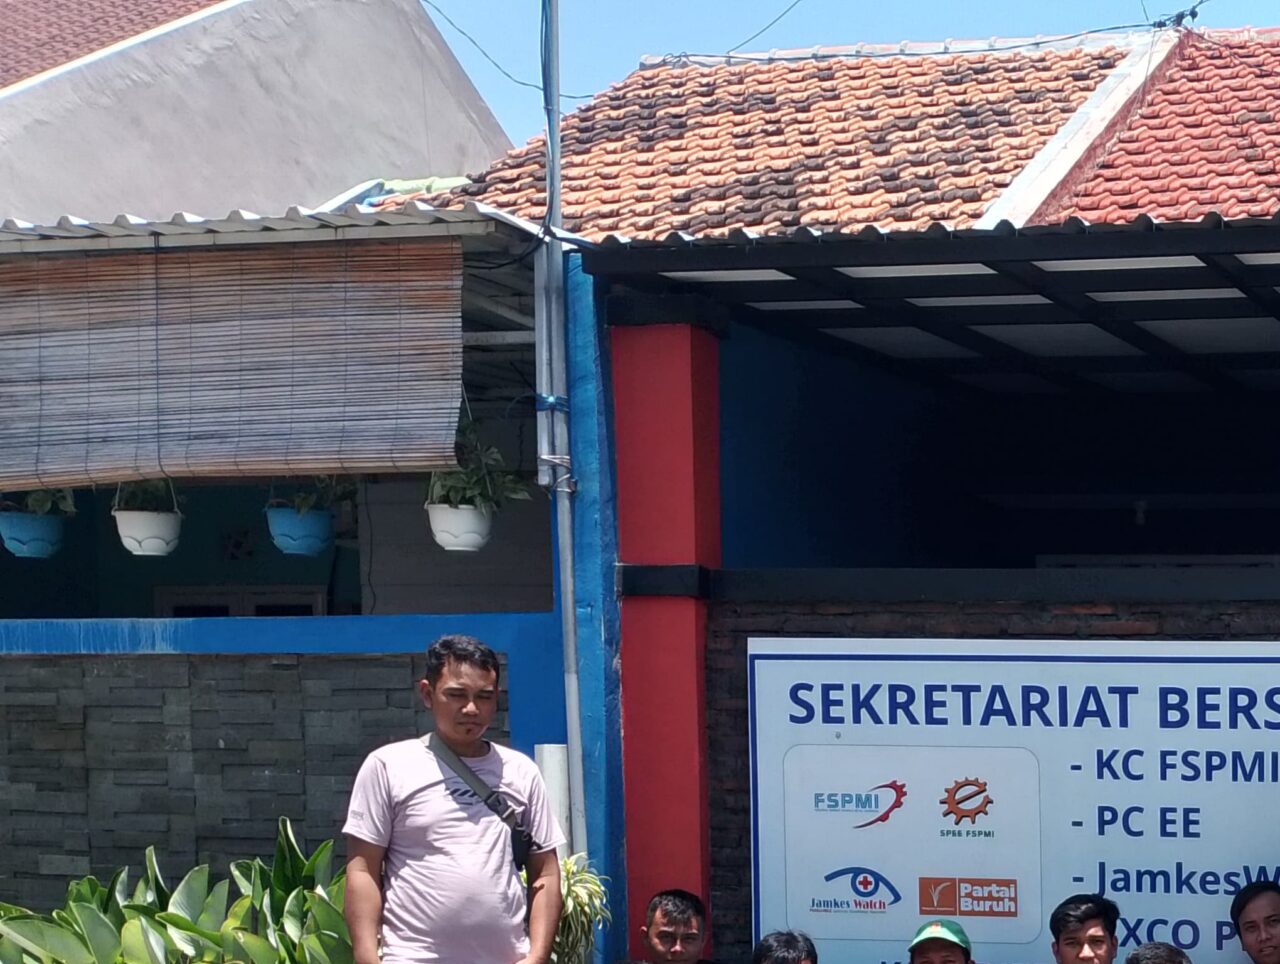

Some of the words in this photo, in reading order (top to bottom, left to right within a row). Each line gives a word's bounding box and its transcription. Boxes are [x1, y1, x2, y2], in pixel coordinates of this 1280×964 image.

[788, 682, 1139, 729] SEKRETARIAT
[1096, 749, 1144, 781] KC
[1159, 750, 1279, 782] FSPMI
[814, 792, 879, 809] FSPMI
[1097, 805, 1144, 837] PC
[1159, 807, 1201, 838] EE
[965, 829, 995, 838] FSPMI
[959, 882, 1015, 898] Partai
[810, 896, 850, 909] Jamkes
[853, 898, 886, 910] Watch
[959, 898, 1016, 913] Buruh
[1118, 917, 1200, 949] XCO
